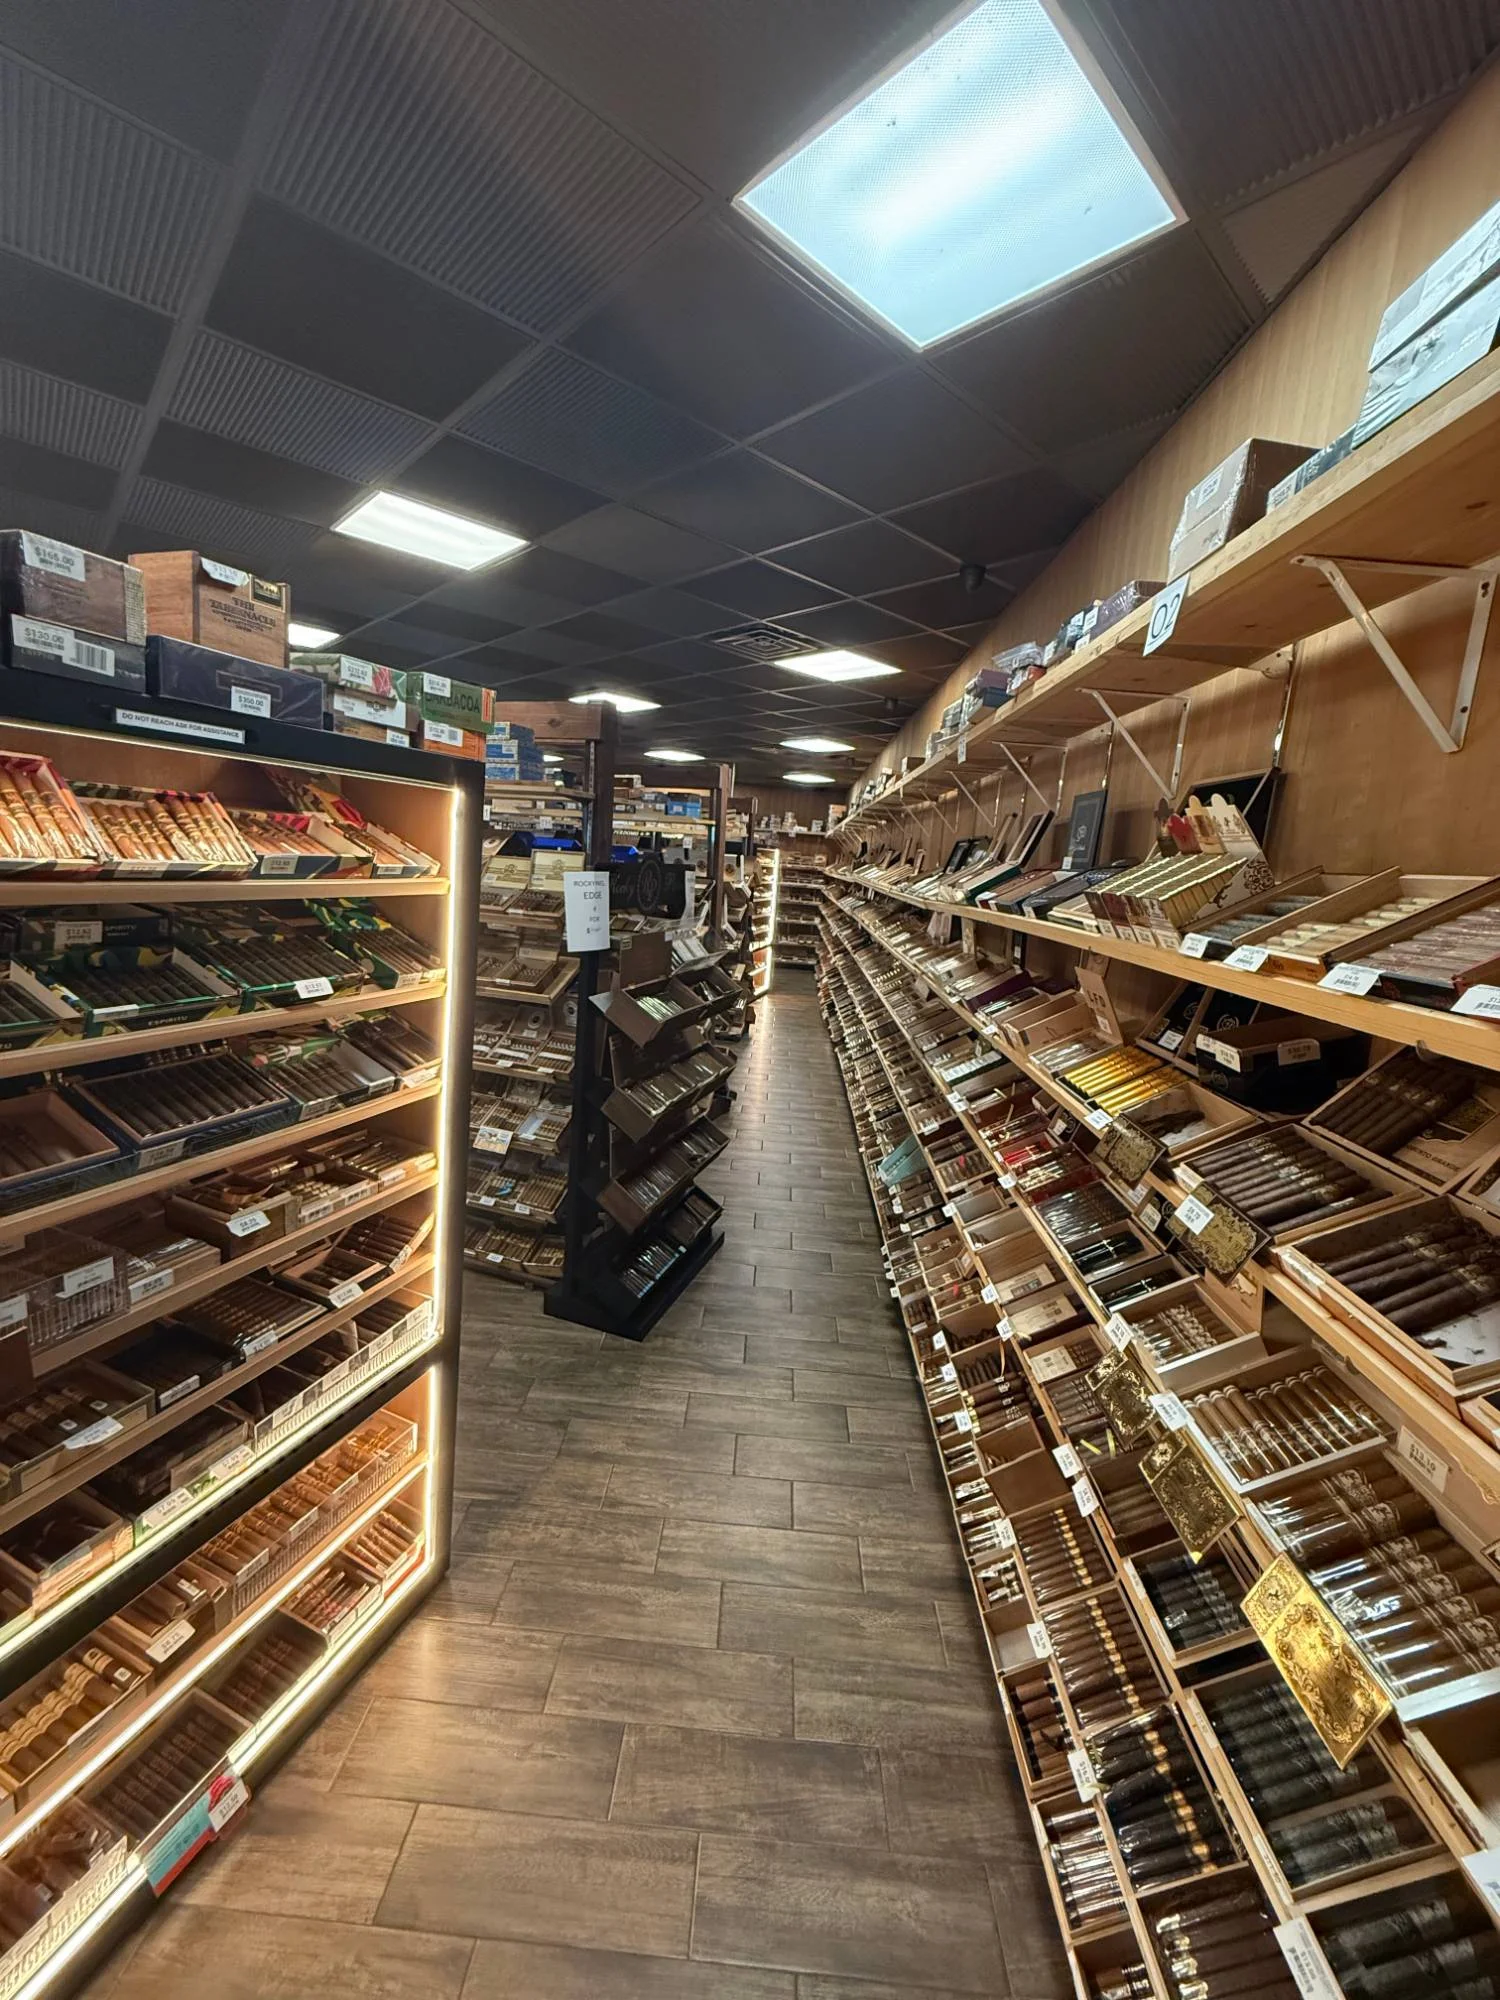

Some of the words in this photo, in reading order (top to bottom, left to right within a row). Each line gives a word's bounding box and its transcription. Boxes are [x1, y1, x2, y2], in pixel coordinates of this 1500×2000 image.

[1151, 593, 1181, 639] 02
[121, 712, 134, 720] DO
[134, 715, 150, 723] NOT
[150, 717, 175, 727] REACH
[583, 892, 602, 900] EDGE
